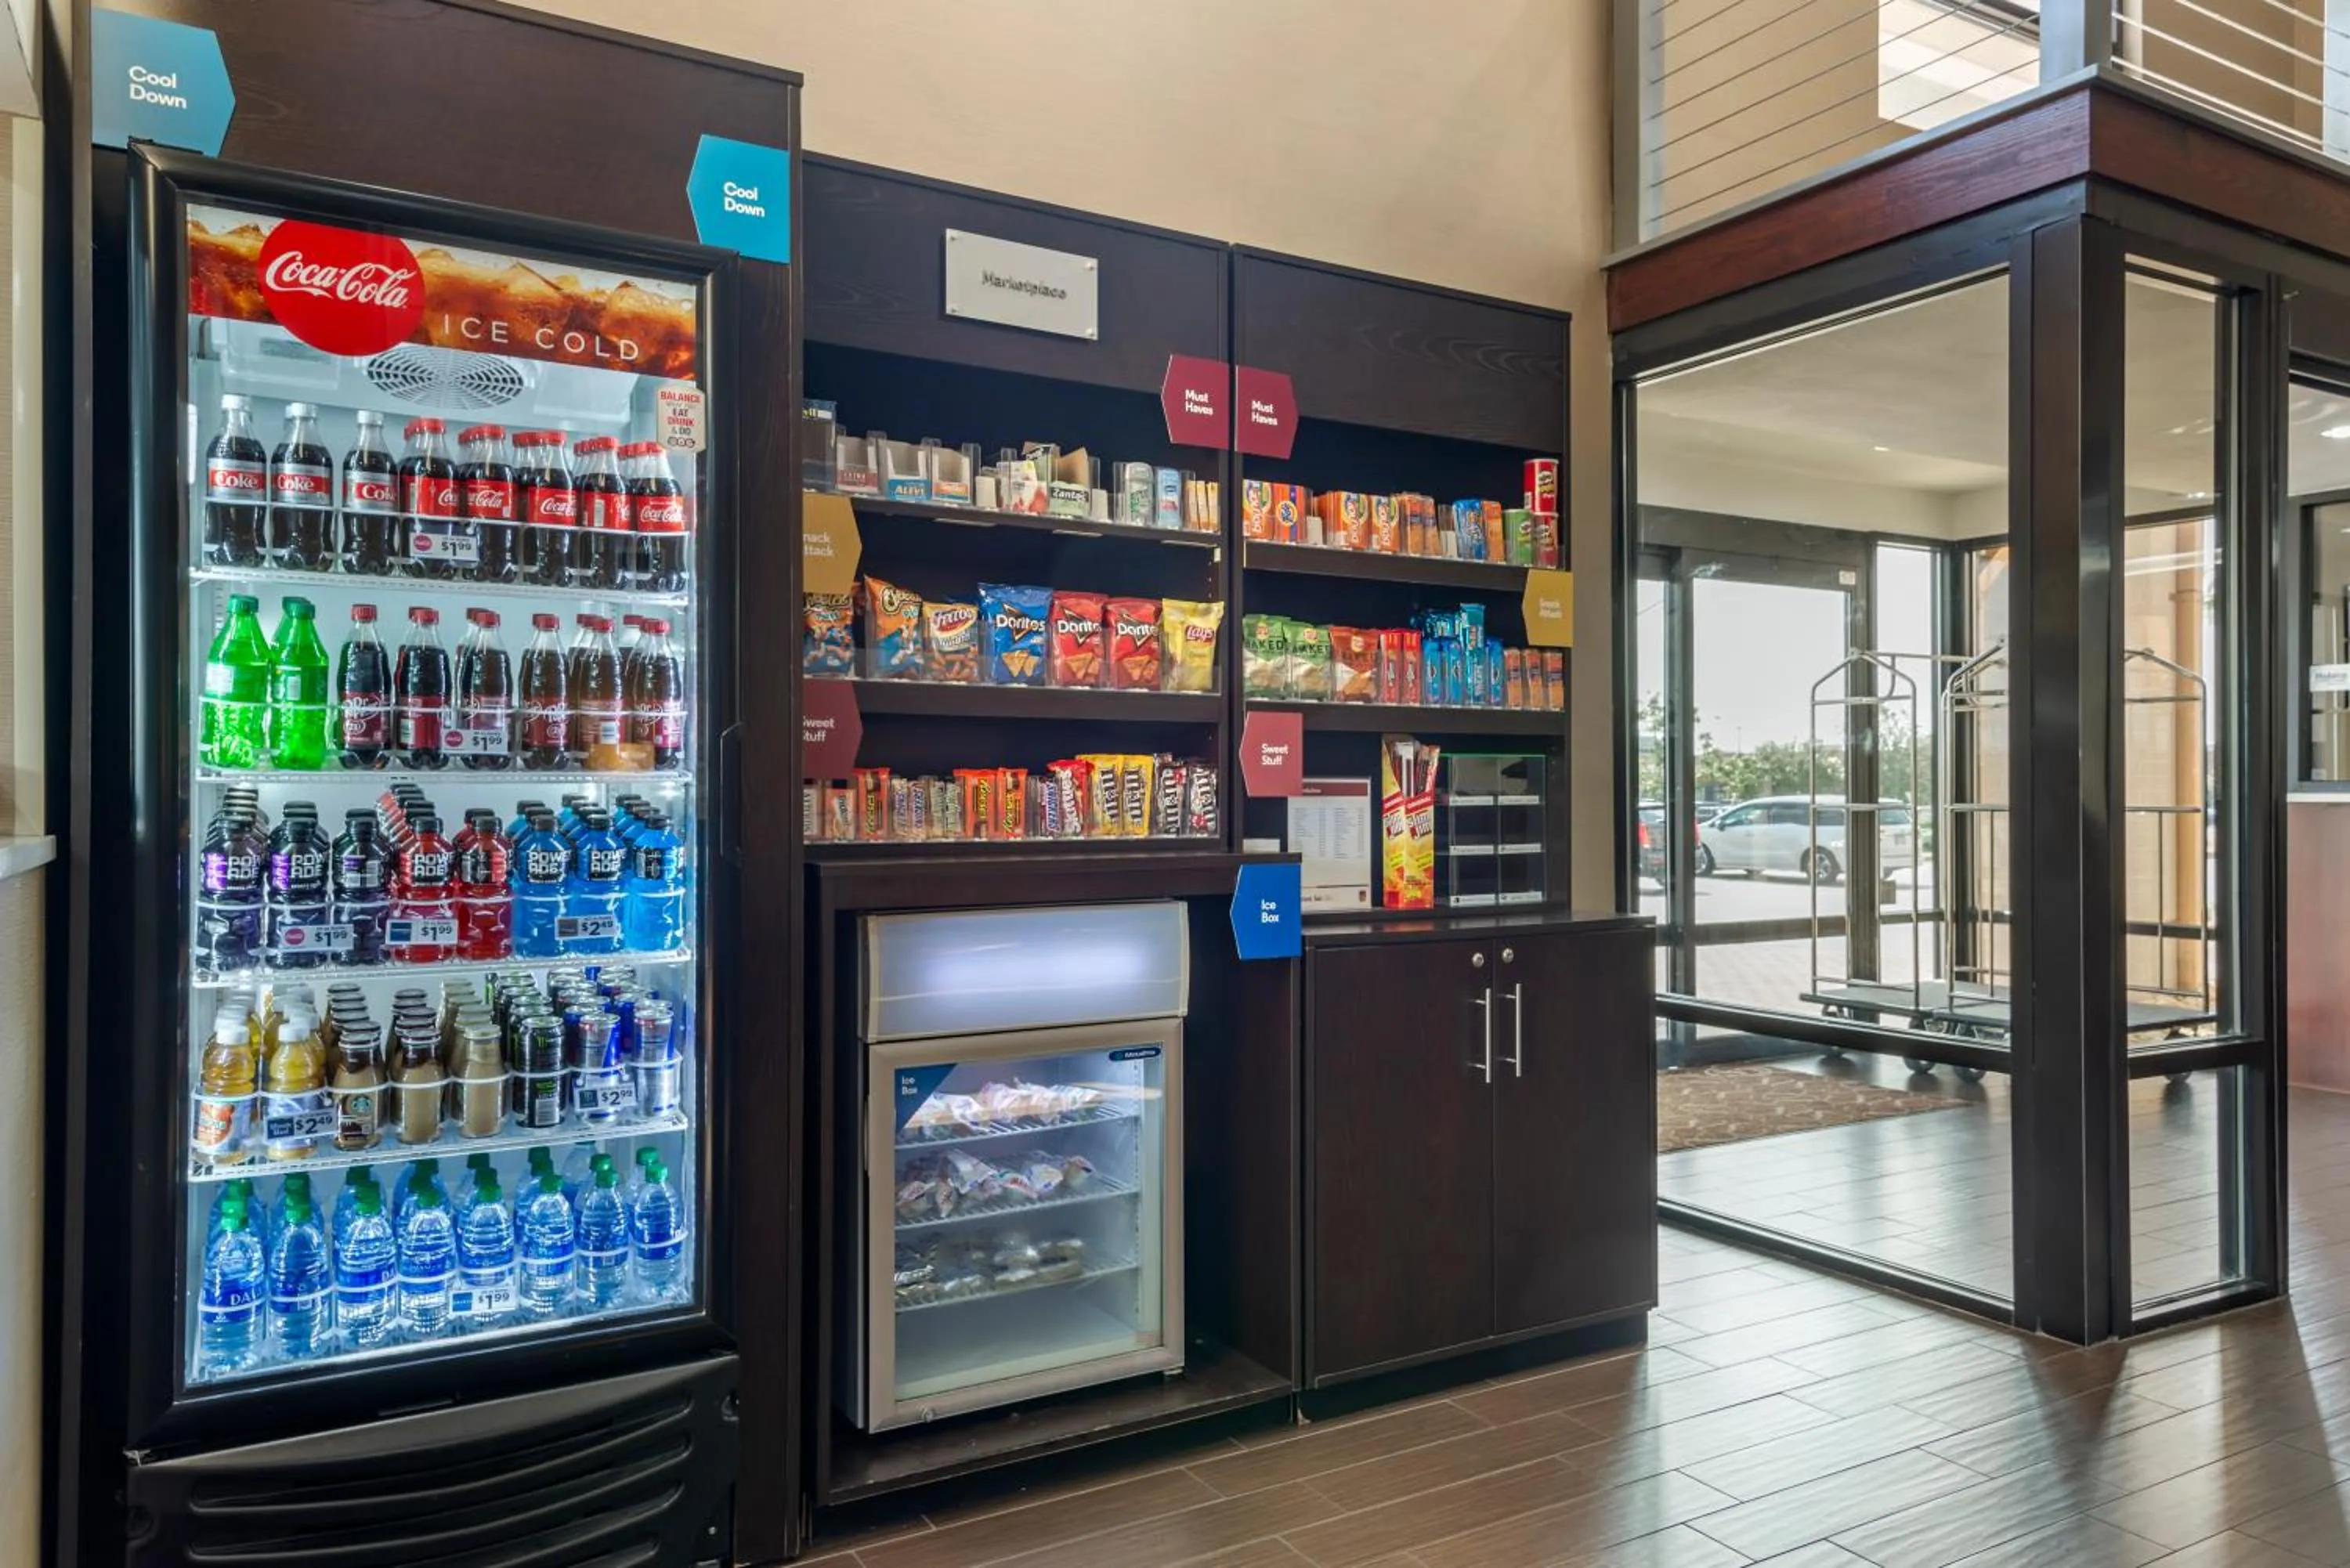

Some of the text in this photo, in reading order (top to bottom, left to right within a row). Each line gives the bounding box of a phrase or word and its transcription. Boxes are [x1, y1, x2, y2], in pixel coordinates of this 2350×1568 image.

[129, 66, 177, 89] Cool
[129, 84, 187, 110] Down
[723, 181, 758, 201] Cool
[723, 197, 765, 218] Down
[265, 251, 418, 311] Coca-Cola
[981, 269, 1067, 301] Marketplace
[443, 313, 640, 363] ICE COLD
[1184, 389, 1209, 403] Must
[1184, 400, 1213, 416] Haves
[1251, 399, 1274, 414] Must
[1251, 411, 1278, 427] Haves
[803, 533, 831, 544] nack
[803, 544, 835, 557] ttack
[996, 612, 1047, 632] Doritos
[1058, 619, 1103, 634] Dorito
[1261, 742, 1289, 755] Sweet
[1261, 754, 1282, 766] Stuff
[1261, 899, 1277, 912] Ice
[1261, 911, 1280, 923] Box
[902, 1076, 916, 1086] Ice
[902, 1086, 918, 1096] Box
